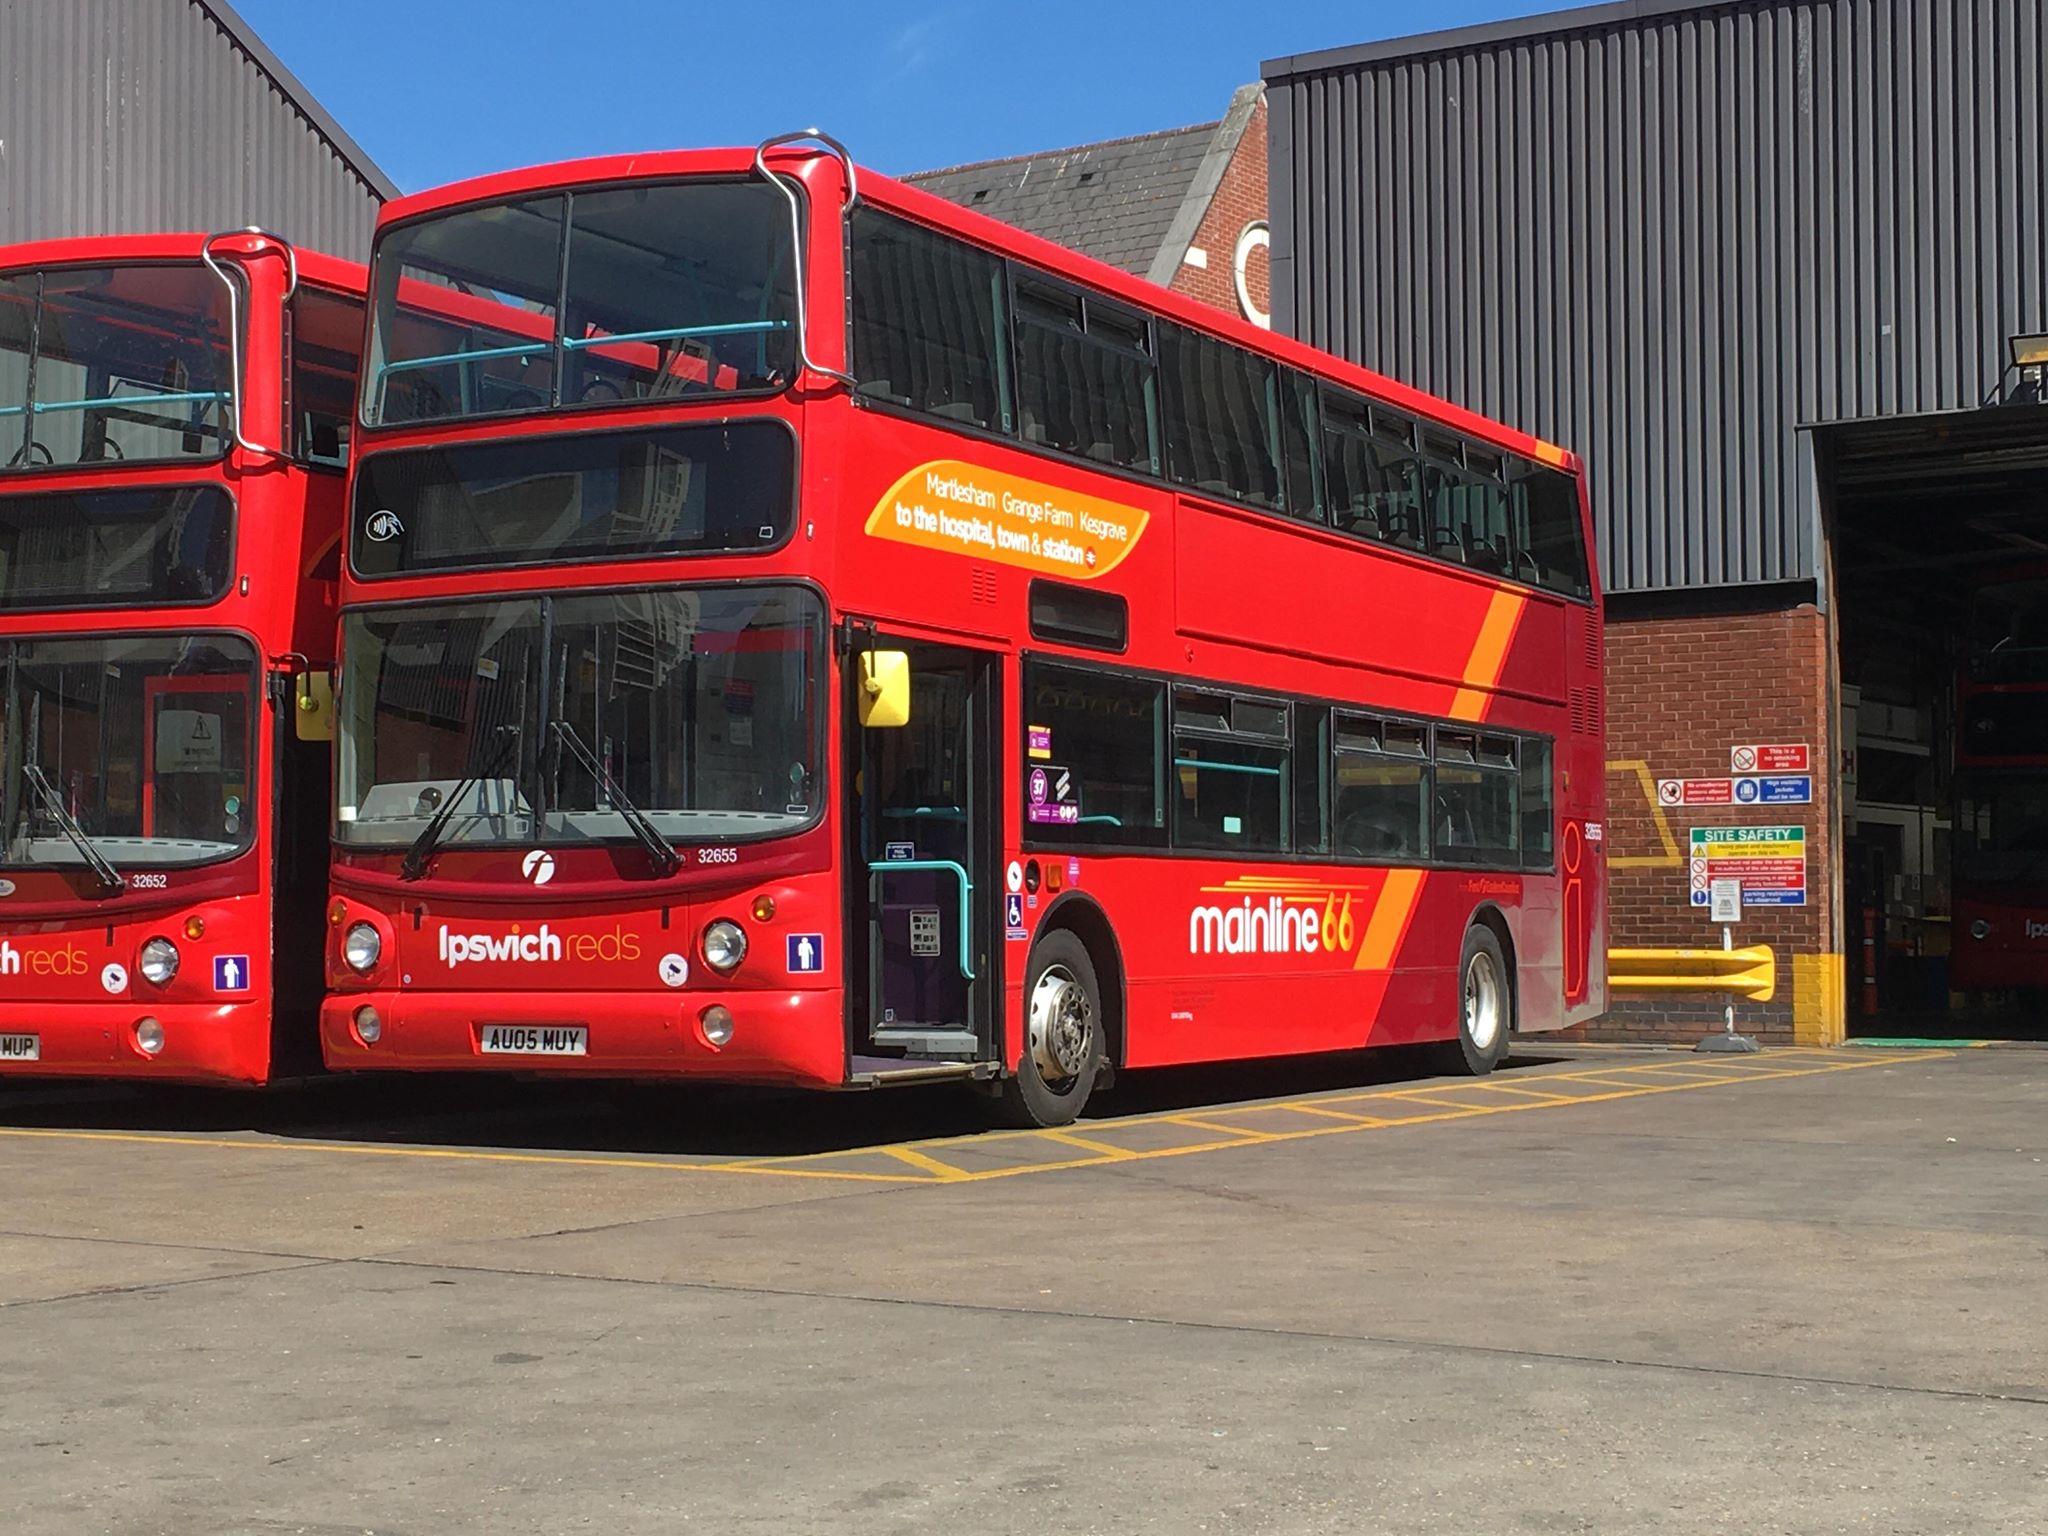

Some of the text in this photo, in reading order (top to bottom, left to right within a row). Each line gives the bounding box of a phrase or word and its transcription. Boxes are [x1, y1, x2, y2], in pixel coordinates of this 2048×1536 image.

[926, 472, 1128, 542] Martlesham Grange Farm Kesgrave
[895, 502, 1084, 565] to the hospital, town & station
[1033, 779, 1045, 795] 37
[1704, 829, 1791, 841] SITE SAFETY
[698, 848, 737, 863] 32655
[132, 875, 167, 888] 32652
[1190, 891, 1354, 953] mainline 66
[438, 924, 641, 969] Ipswich reds
[24, 942, 89, 975] reds
[2, 1037, 33, 1056] MUP
[490, 1029, 580, 1051] AU05 MUY
